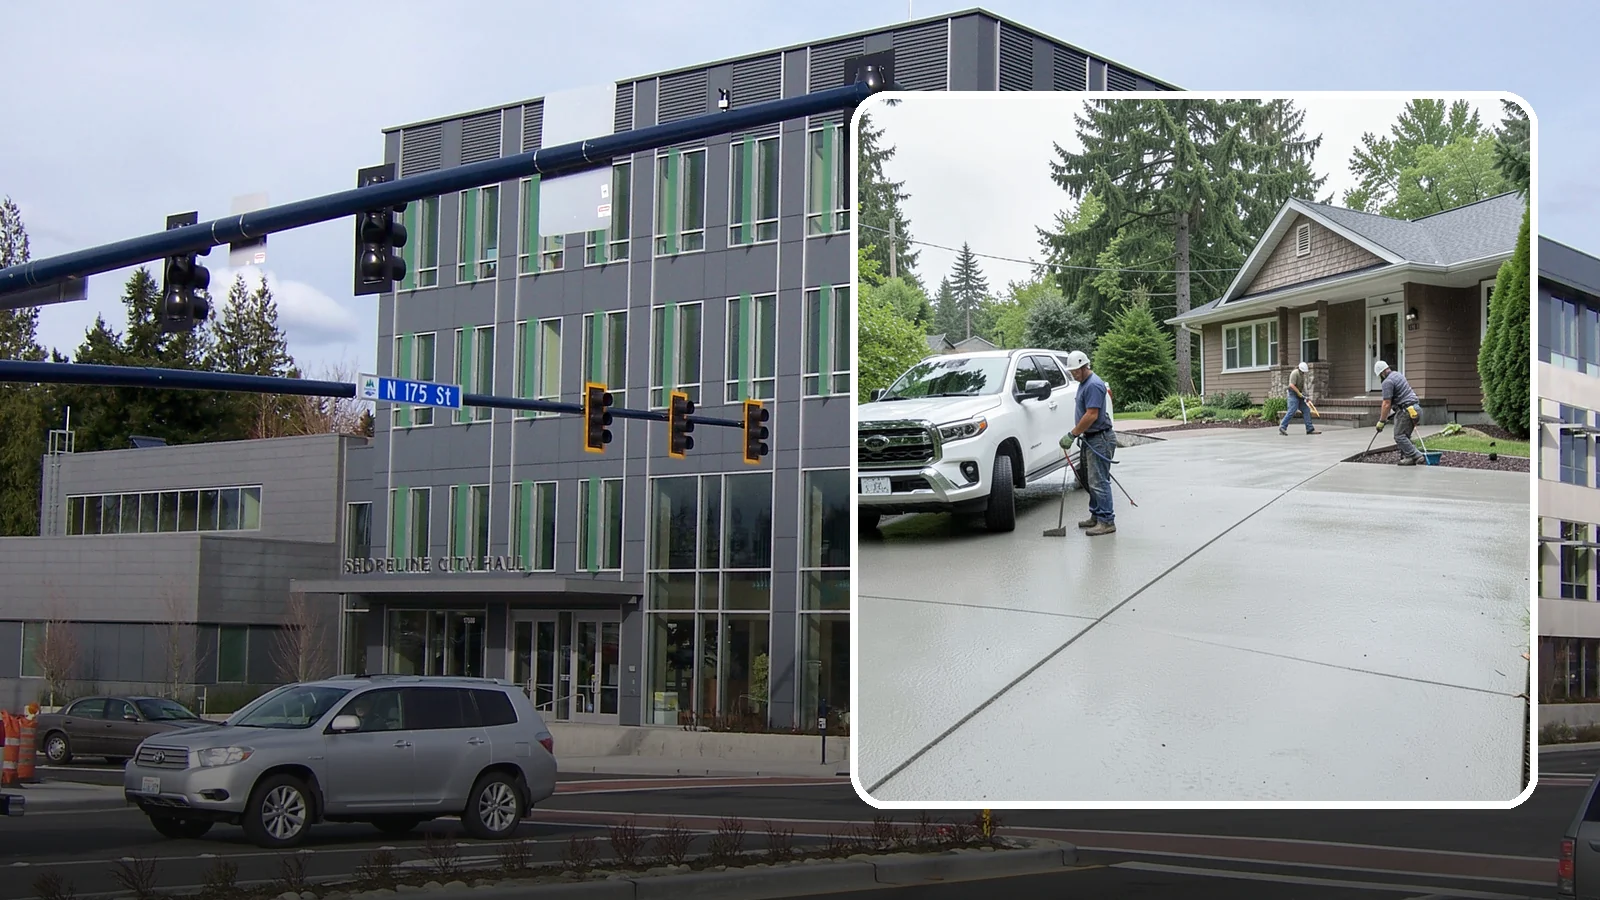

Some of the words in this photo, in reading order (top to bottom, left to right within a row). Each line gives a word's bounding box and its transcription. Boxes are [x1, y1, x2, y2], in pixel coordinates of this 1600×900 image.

[387, 380, 396, 400] N
[405, 382, 428, 403] 175
[436, 386, 451, 406] St
[344, 556, 432, 574] SHORELINE
[438, 556, 475, 572] CITY
[483, 555, 525, 571] HALL
